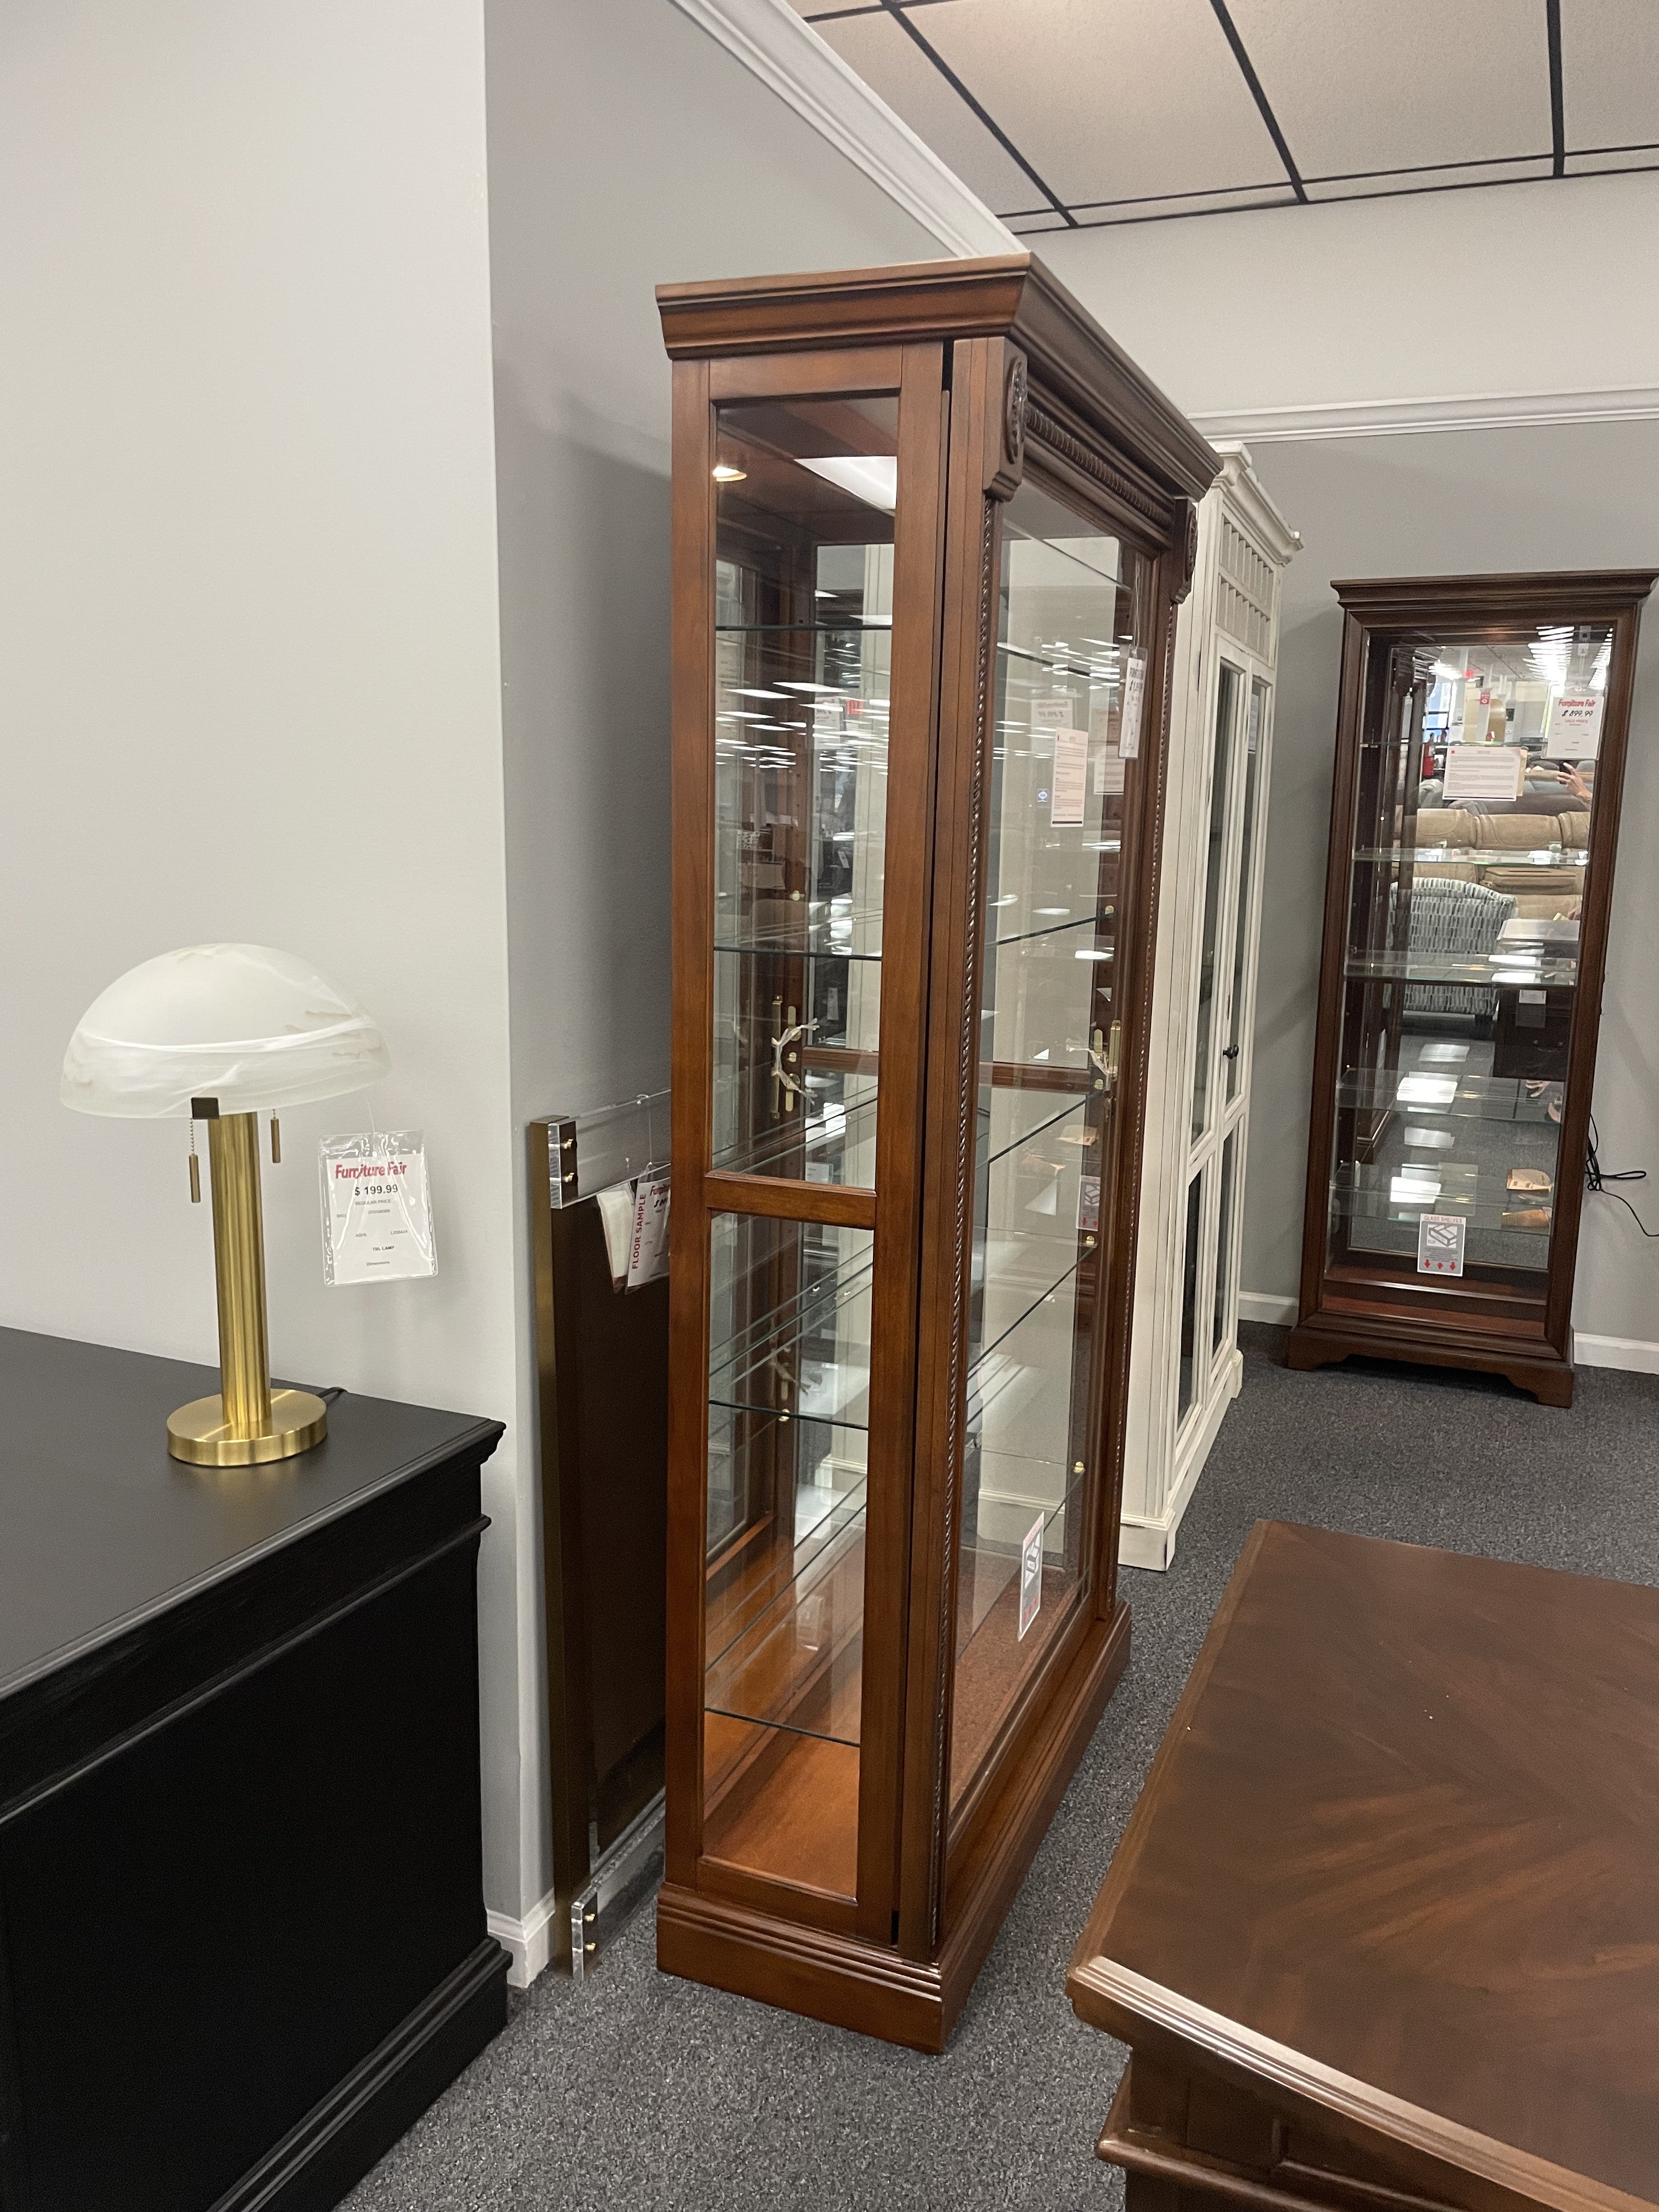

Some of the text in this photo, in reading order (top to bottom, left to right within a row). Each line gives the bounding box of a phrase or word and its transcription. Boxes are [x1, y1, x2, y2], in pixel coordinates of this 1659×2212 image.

[335, 1161, 407, 1179] Furniture Fair
[354, 1184, 398, 1196] $ 199.99
[632, 1194, 646, 1269] FLOOR SAMPLE
